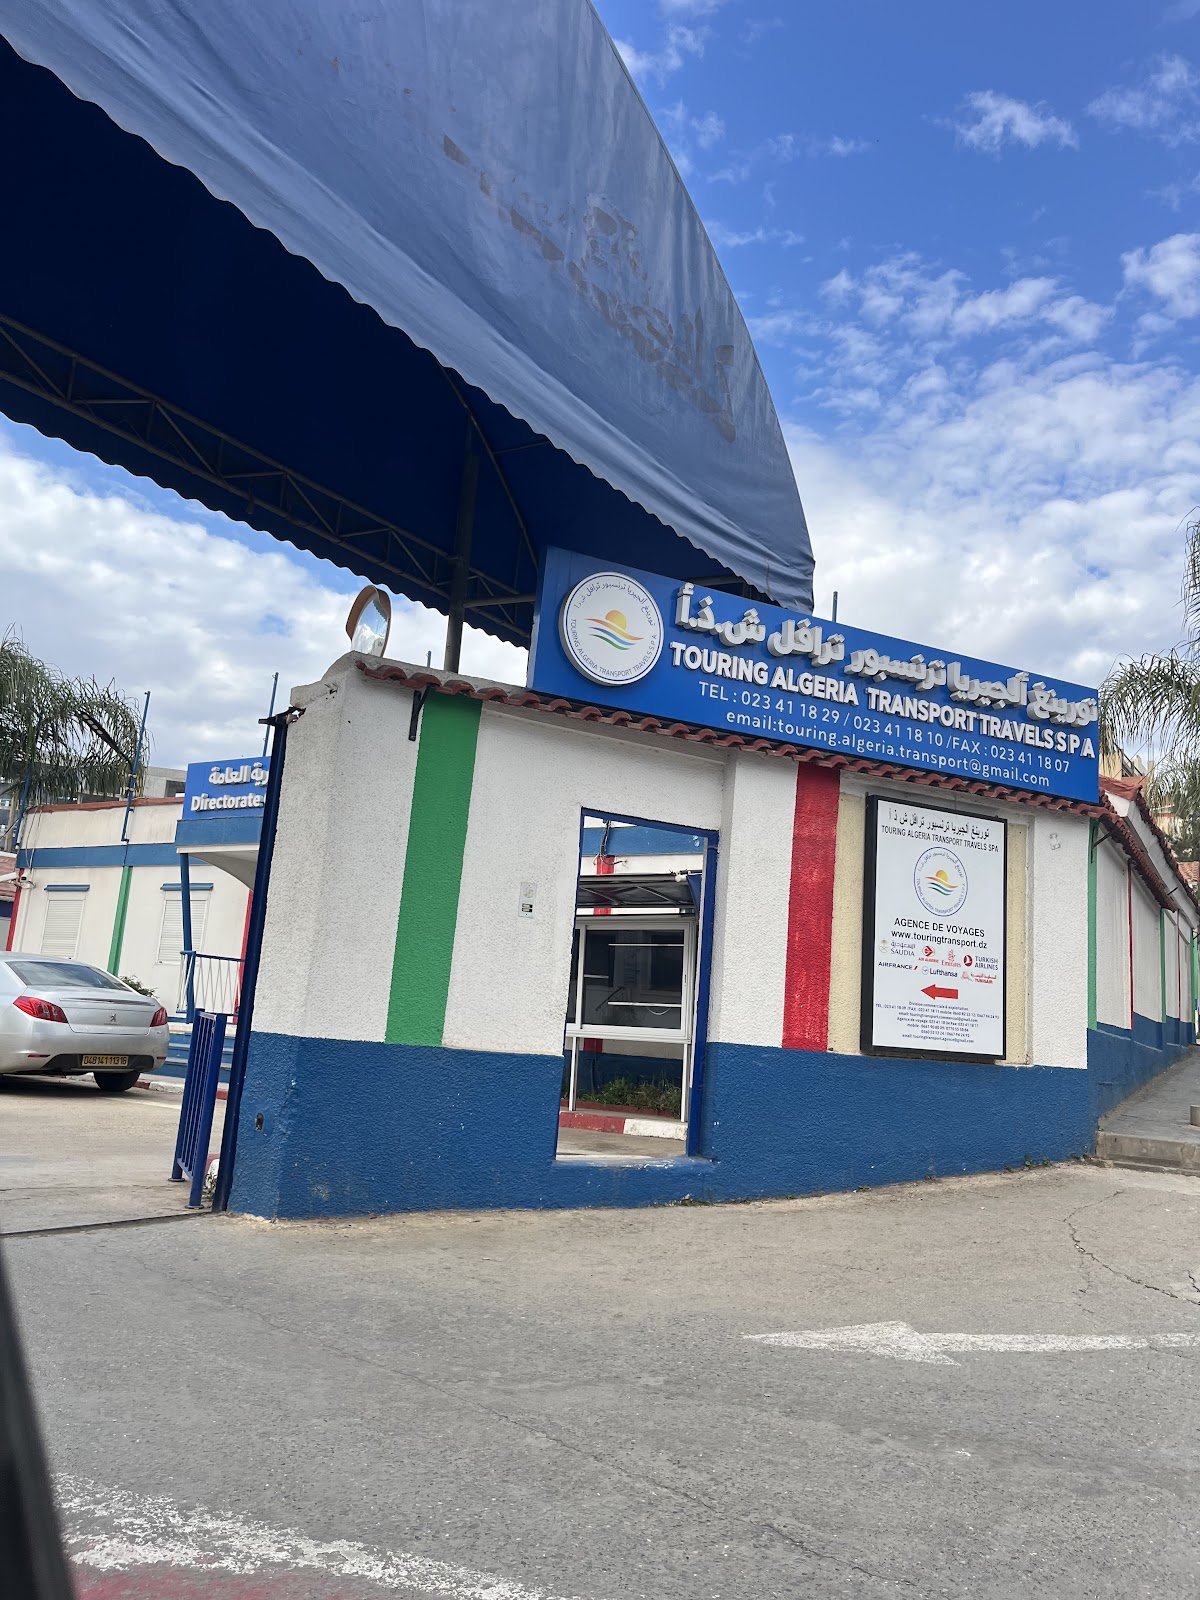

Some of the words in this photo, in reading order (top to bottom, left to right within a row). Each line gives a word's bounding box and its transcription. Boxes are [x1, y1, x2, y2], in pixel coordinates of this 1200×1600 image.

[570, 619, 581, 648] TOURING
[577, 648, 598, 670] ALGERIA
[599, 666, 632, 678] TRANSPORT
[633, 651, 652, 672] TRAVELS
[767, 618, 845, 667] ترافل
[843, 647, 947, 692] ترنسبور
[670, 641, 769, 686] TOURING
[769, 666, 859, 706] ALGERIA
[866, 686, 977, 732] TRANSPORT
[975, 715, 1054, 750] TRAVELS
[741, 690, 771, 710] 023
[775, 699, 793, 715] 41
[800, 703, 817, 719] 18
[821, 708, 840, 724] 29
[853, 716, 880, 733] 023
[886, 723, 900, 738] 41
[906, 727, 923, 743] 18
[927, 731, 943, 747] 10
[990, 747, 1015, 762] 023
[1017, 752, 1033, 766] 41
[1037, 755, 1052, 770] 18
[1054, 758, 1070, 773] 07
[209, 765, 251, 785] العامة
[191, 793, 263, 811] Directorate
[881, 825, 906, 837] TOURING
[907, 831, 931, 841] ALGERIA
[932, 834, 962, 847] TRANSPORT
[964, 839, 987, 851] TRAVELS
[988, 844, 999, 853] SPA
[894, 918, 929, 930] AGENCE
[932, 923, 943, 932] DE
[946, 924, 985, 937] VOYAGES
[891, 930, 988, 949] www.touringtransport.dz
[890, 948, 915, 957] SAUDIA
[975, 955, 999, 964] TURKISH
[929, 968, 958, 977] Lufthansa
[974, 962, 999, 971] AIRLINES
